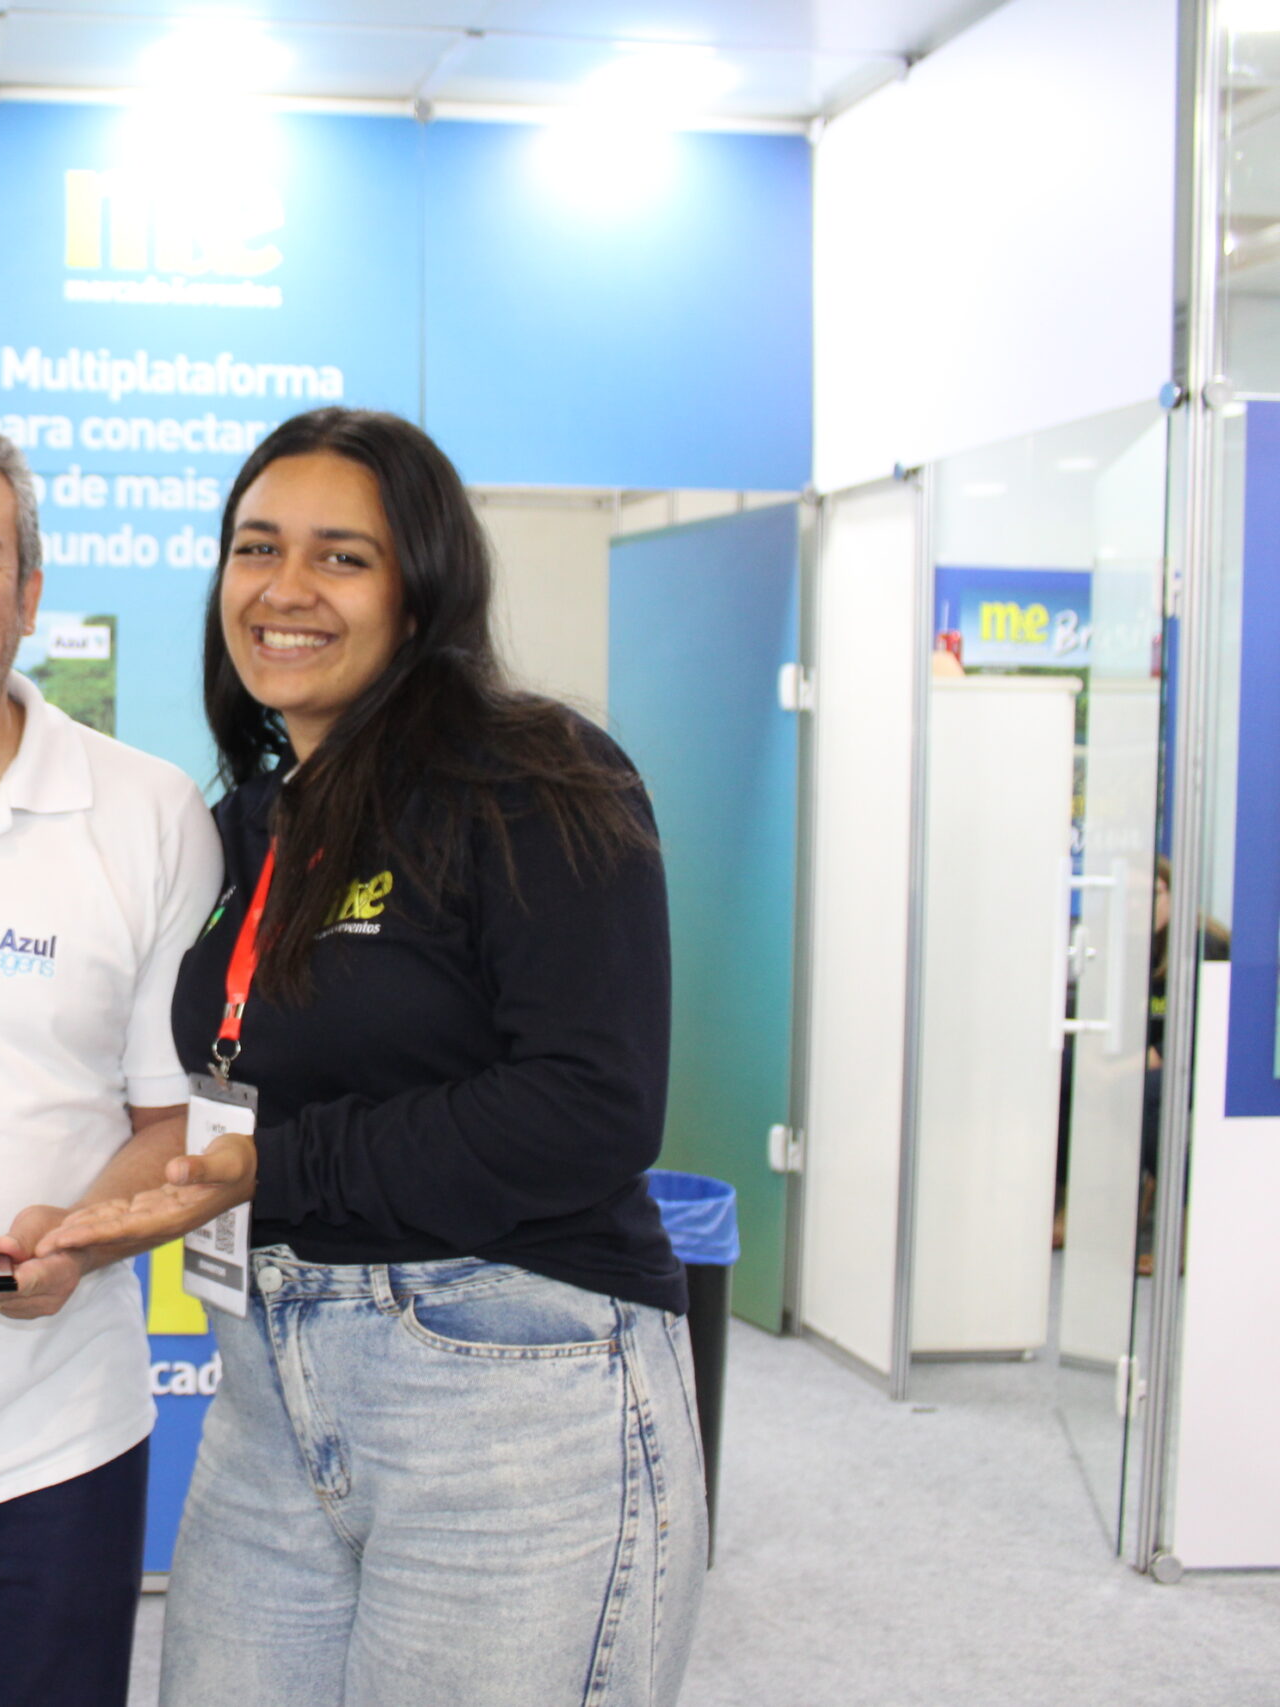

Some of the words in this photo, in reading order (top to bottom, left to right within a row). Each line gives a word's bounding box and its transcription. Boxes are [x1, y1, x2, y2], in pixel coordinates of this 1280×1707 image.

[0, 346, 344, 402] Multiplataforma
[79, 414, 265, 454] conectar
[52, 463, 108, 507] de
[115, 466, 221, 510] mais
[0, 929, 57, 958] Azul
